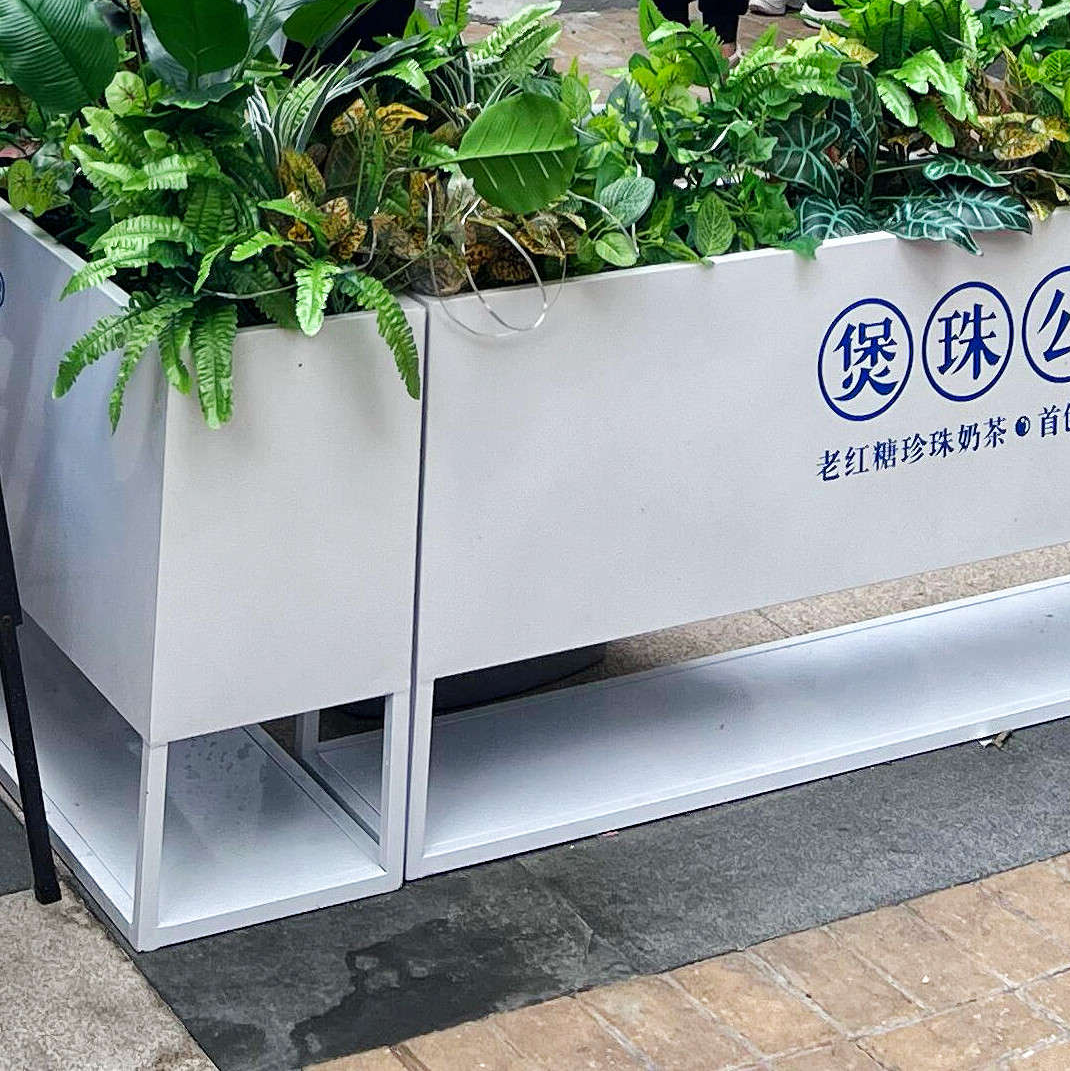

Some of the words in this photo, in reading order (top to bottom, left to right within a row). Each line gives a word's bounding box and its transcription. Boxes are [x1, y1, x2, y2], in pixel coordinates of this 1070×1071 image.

[816, 416, 1007, 482] 老红糖珍珠奶茶
